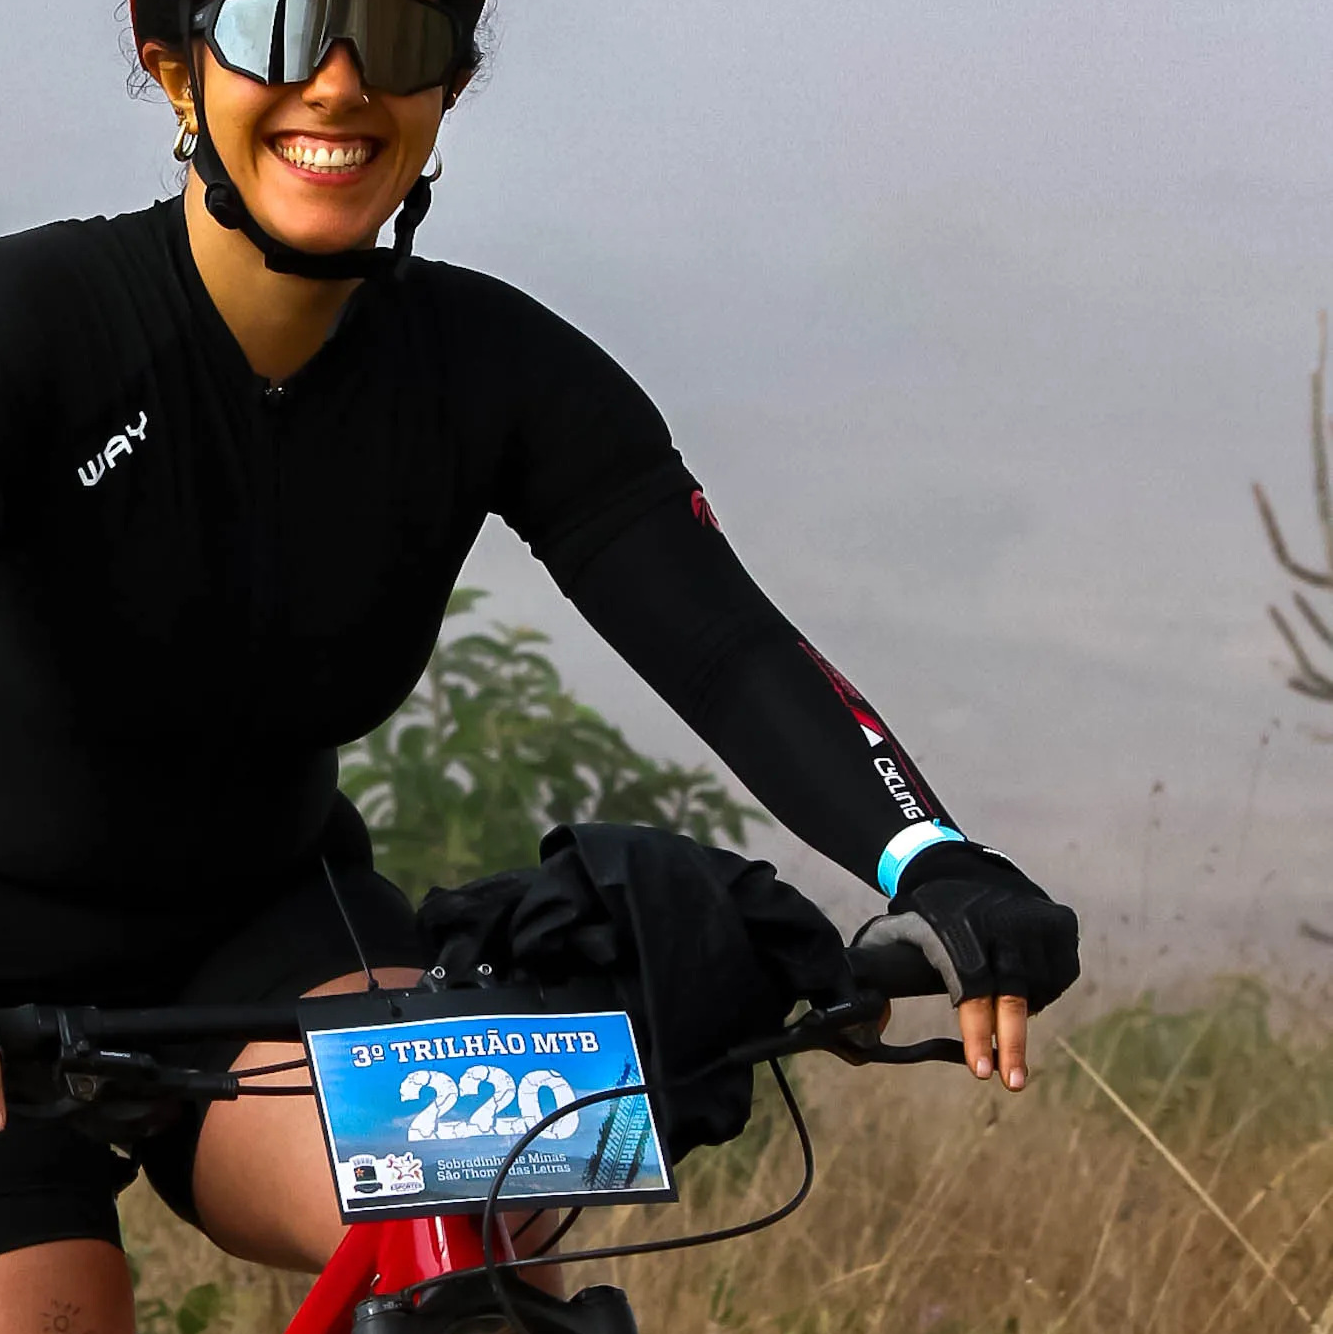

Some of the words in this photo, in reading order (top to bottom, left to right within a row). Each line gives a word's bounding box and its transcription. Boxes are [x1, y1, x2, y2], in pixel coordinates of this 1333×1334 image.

[77, 410, 148, 487] WAY
[873, 757, 926, 820] CYCLING
[351, 1043, 385, 1068] 3º
[390, 1028, 526, 1063] TRILHÃO
[531, 1030, 600, 1054] MTB
[399, 1064, 580, 1142] 220
[436, 1169, 461, 1181] São
[462, 1167, 500, 1180] Thom
[508, 1162, 531, 1176] das
[532, 1163, 571, 1175] Letras
[528, 1152, 567, 1164] Minas
